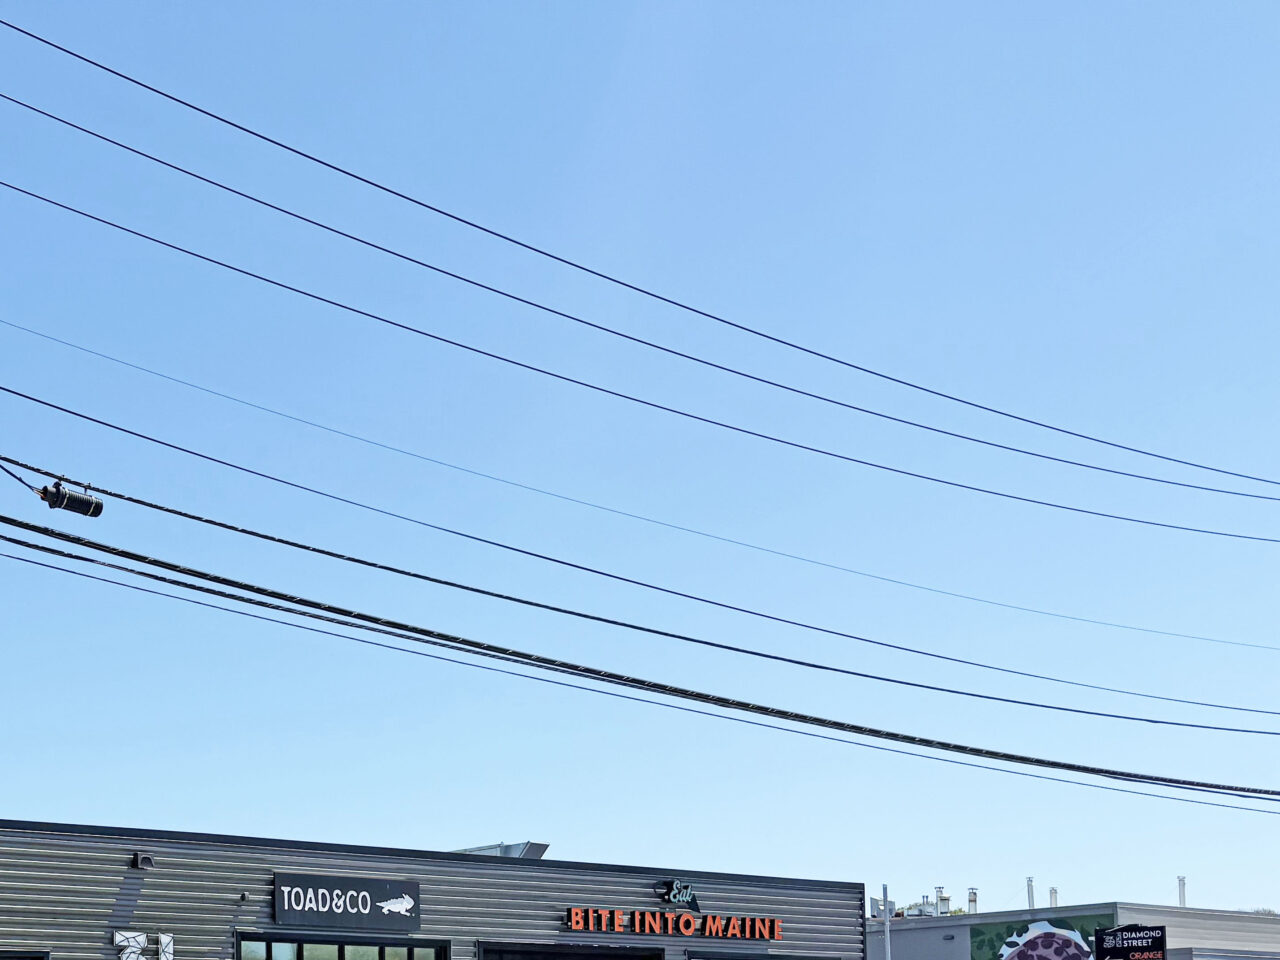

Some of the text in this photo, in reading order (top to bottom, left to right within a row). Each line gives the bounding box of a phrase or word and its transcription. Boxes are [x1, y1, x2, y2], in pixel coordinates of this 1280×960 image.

[670, 879, 693, 903] Eat
[281, 886, 370, 914] TOAD&CO
[571, 907, 783, 940] BITE INTO MAINE
[1123, 930, 1162, 938] DIAMOND
[1123, 939, 1152, 947] STREET
[1129, 951, 1163, 959] ORANGE
